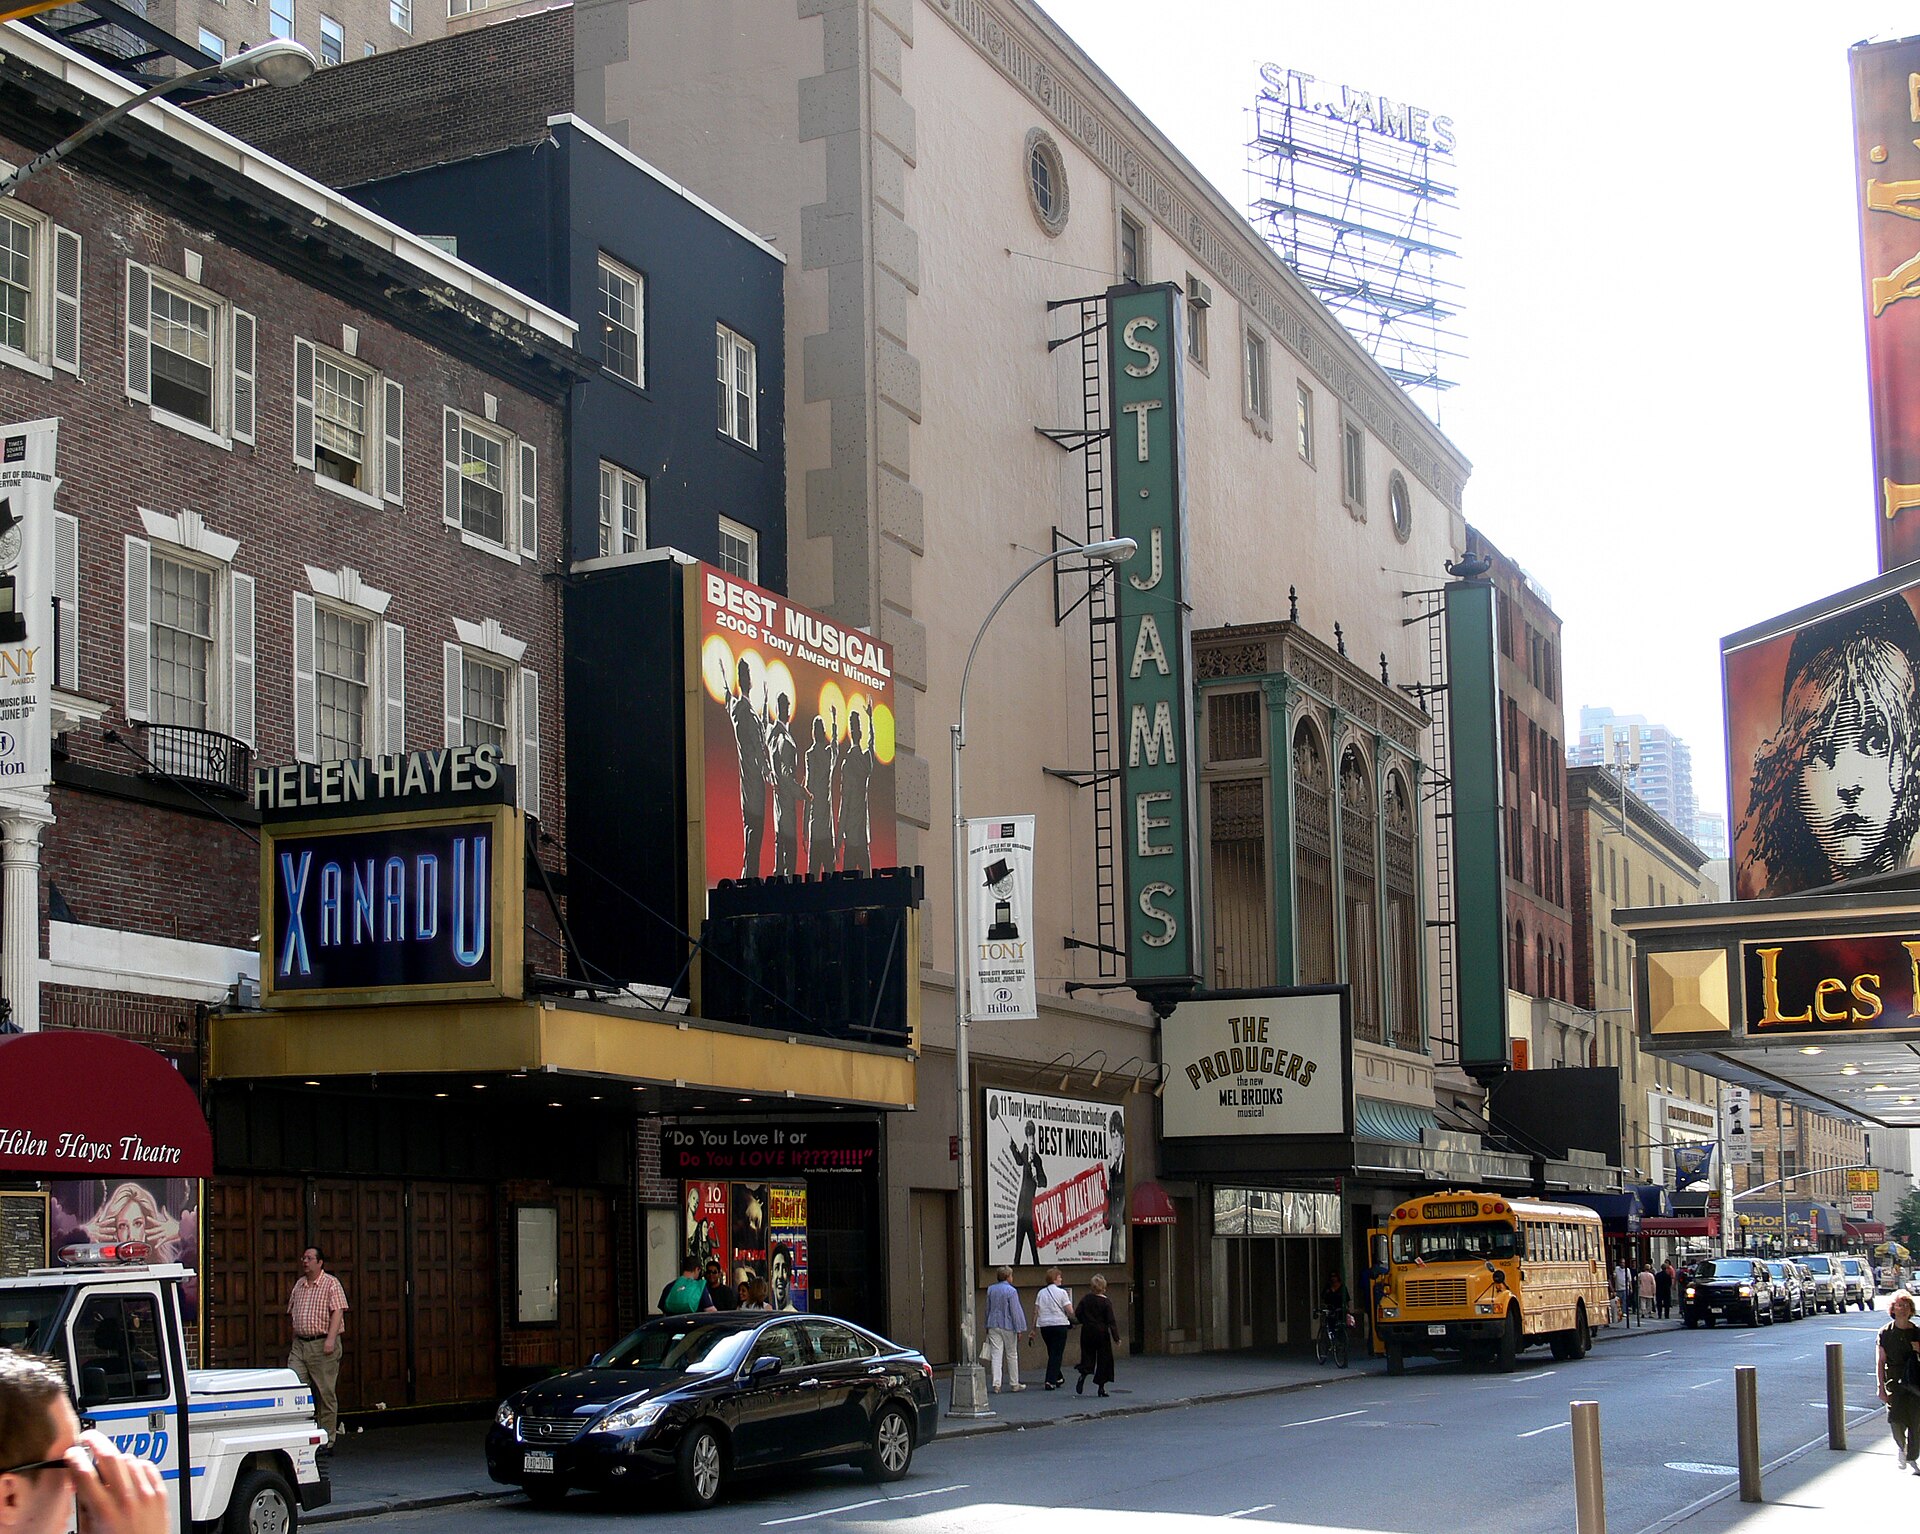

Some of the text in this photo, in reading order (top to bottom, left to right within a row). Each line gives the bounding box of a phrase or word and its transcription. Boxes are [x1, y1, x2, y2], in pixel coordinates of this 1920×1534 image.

[1260, 62, 1457, 154] ST. JAMES
[21, 471, 52, 483] BROADWAY
[707, 573, 891, 678] BEST MUSICAL
[0, 647, 40, 678] NY
[716, 611, 885, 691] 2006 Tony Award Winner
[0, 708, 20, 720] JUNE
[21, 695, 37, 705] HALL
[1128, 527, 1177, 947] JAMES
[254, 744, 499, 810] HELEN HAYES
[280, 836, 486, 977] XANADU
[977, 941, 1027, 960] TONY
[1756, 947, 1883, 1027] Les
[987, 1003, 1020, 1013] Hilton
[1228, 1016, 1270, 1044] THE
[1185, 1046, 1317, 1091] PRODUCERS
[1237, 1075, 1263, 1086] the new
[1219, 1088, 1283, 1106] MEL BROOKS
[1001, 1096, 1107, 1130] 11 Tony Award Nominations including
[1237, 1106, 1264, 1118] musical
[0, 1129, 181, 1164] Helen Hayes Theatre
[700, 1131, 727, 1145] You
[733, 1130, 768, 1145] Love
[774, 1130, 784, 1144] It
[789, 1132, 807, 1144] or
[1038, 1125, 1108, 1160] BEST MUSICAL
[680, 1152, 700, 1167] Do
[706, 1151, 733, 1166] You
[740, 1151, 785, 1167] LOVE
[708, 1186, 722, 1202] 10
[770, 1197, 807, 1219] HEIGHTS
[1035, 1192, 1064, 1242] SPRING
[1064, 1170, 1105, 1224] AWAKENING
[1427, 1202, 1478, 1218] SCHOOL BUS
[106, 1431, 169, 1466] YPD
